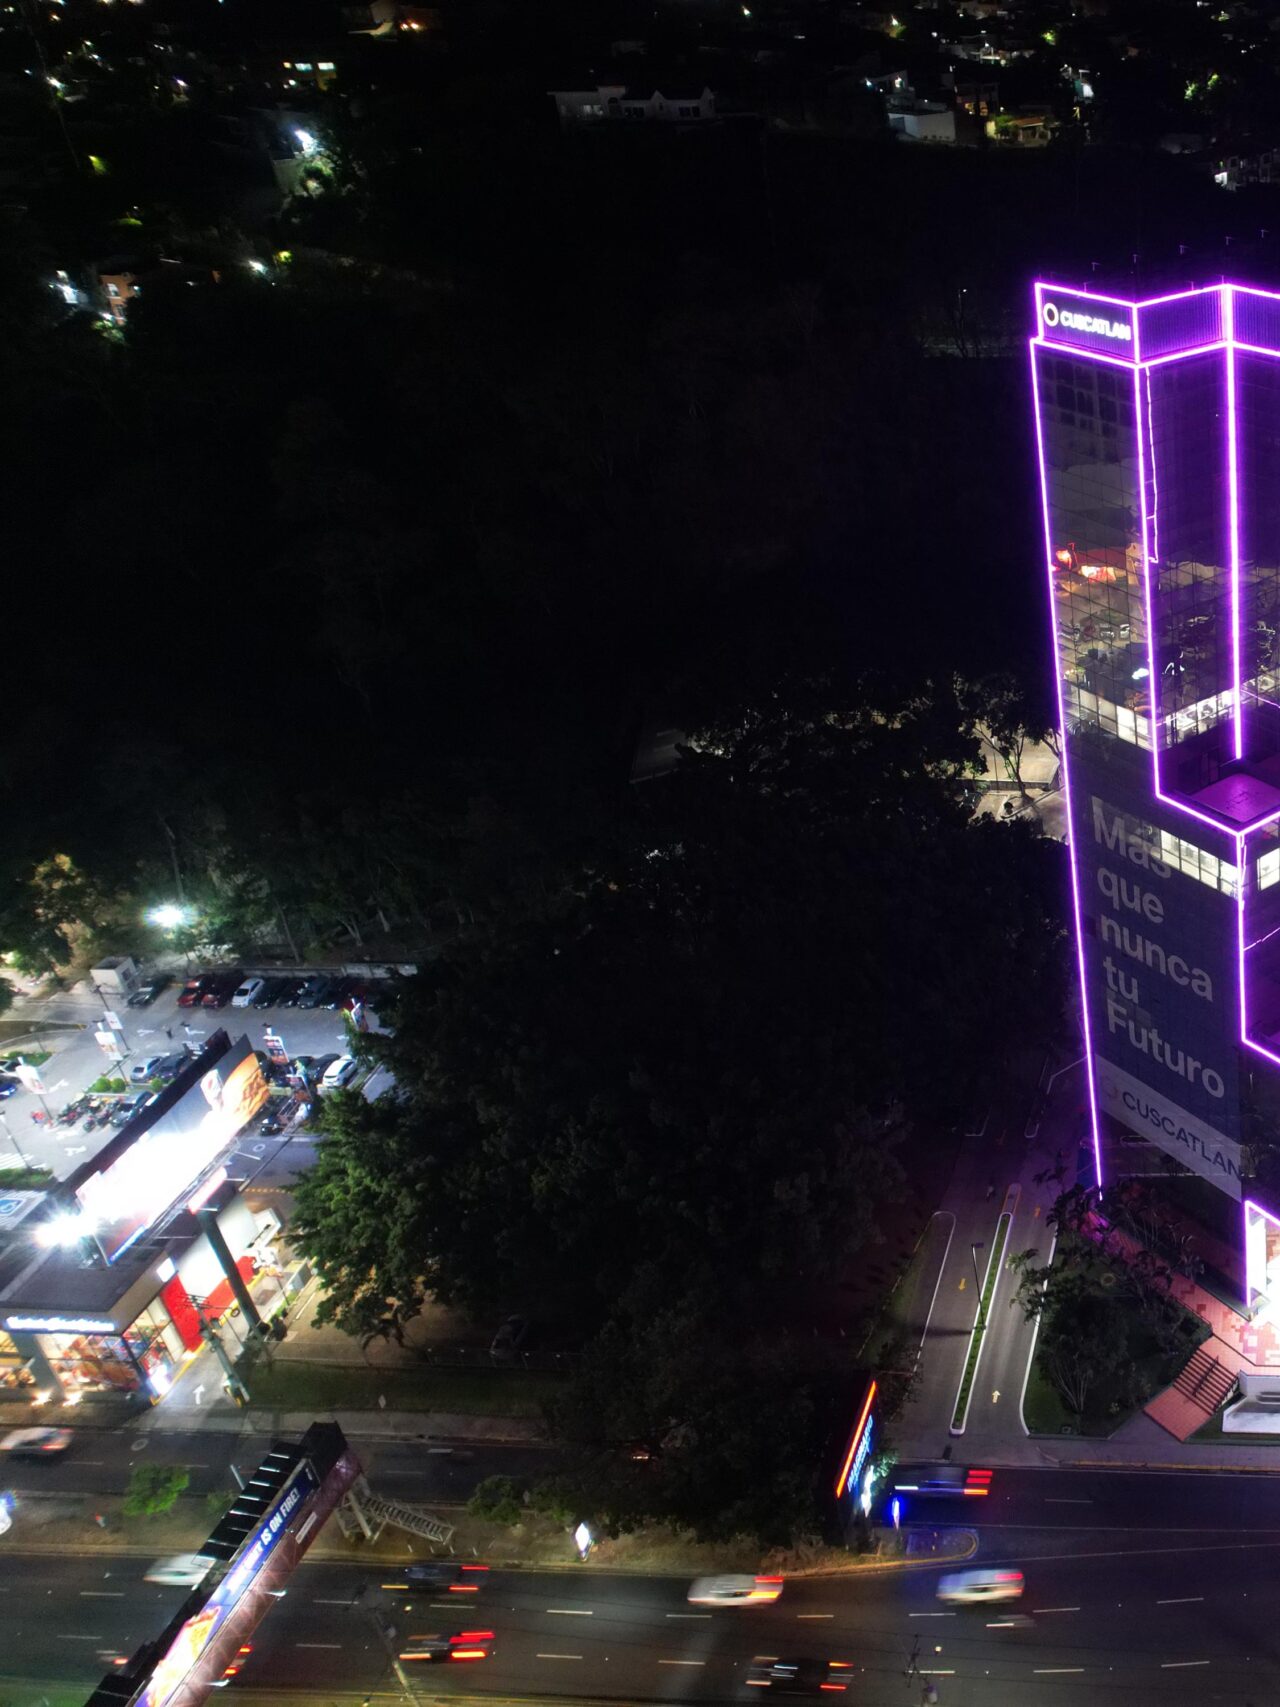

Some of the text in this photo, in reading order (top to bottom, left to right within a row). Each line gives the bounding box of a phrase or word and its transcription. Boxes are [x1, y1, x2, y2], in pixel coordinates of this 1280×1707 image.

[1060, 310, 1131, 340] CUSCATLAN
[1097, 867, 1164, 923] que
[1101, 914, 1213, 1002] nunca
[1103, 956, 1138, 1005] tu
[1107, 996, 1225, 1098] Futuro
[1123, 1091, 1241, 1182] CUSCATLAN
[269, 1512, 283, 1533] ON
[280, 1487, 300, 1518] FIRE!
